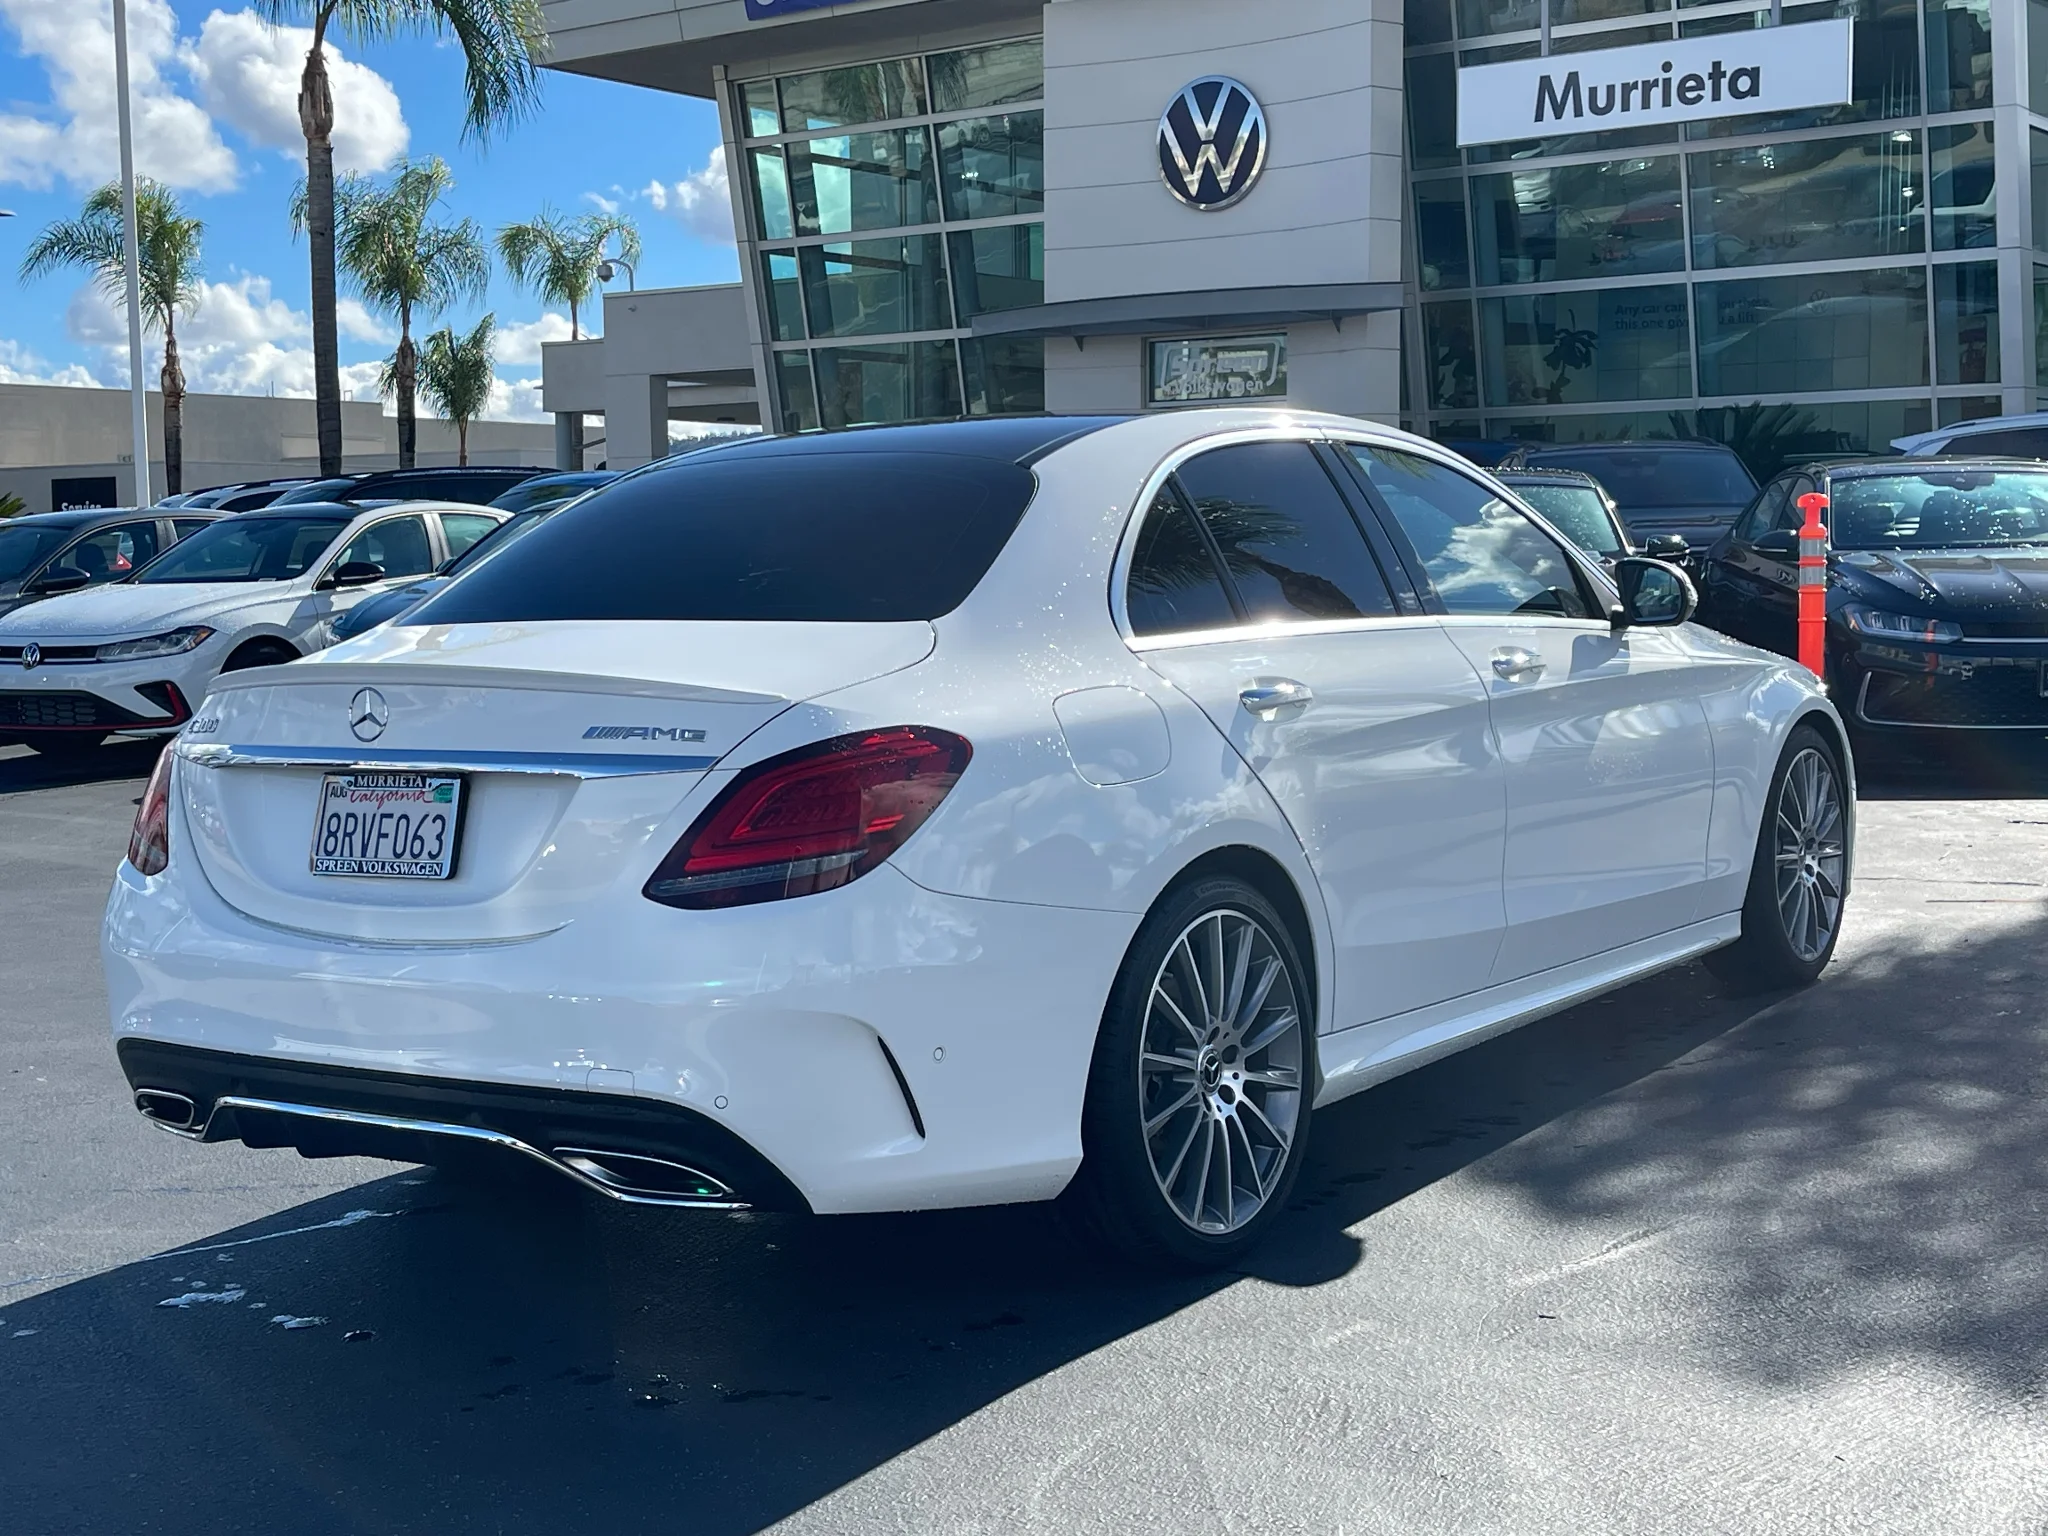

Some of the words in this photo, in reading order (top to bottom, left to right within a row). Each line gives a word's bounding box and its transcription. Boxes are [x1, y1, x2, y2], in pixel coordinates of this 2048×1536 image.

[1534, 61, 1760, 123] Murrieta
[1156, 75, 1266, 212] VW
[1615, 304, 1639, 318] Any
[1642, 305, 1660, 314] car
[1615, 318, 1637, 330] this
[1641, 319, 1664, 328] one
[621, 727, 707, 742] AMG
[357, 775, 423, 787] MURRIETA
[330, 785, 347, 798] AUG
[350, 789, 433, 810] California
[324, 813, 446, 859] 8RVF063
[315, 859, 359, 872] SPREEN
[362, 861, 441, 875] VOLKSWAGEN
